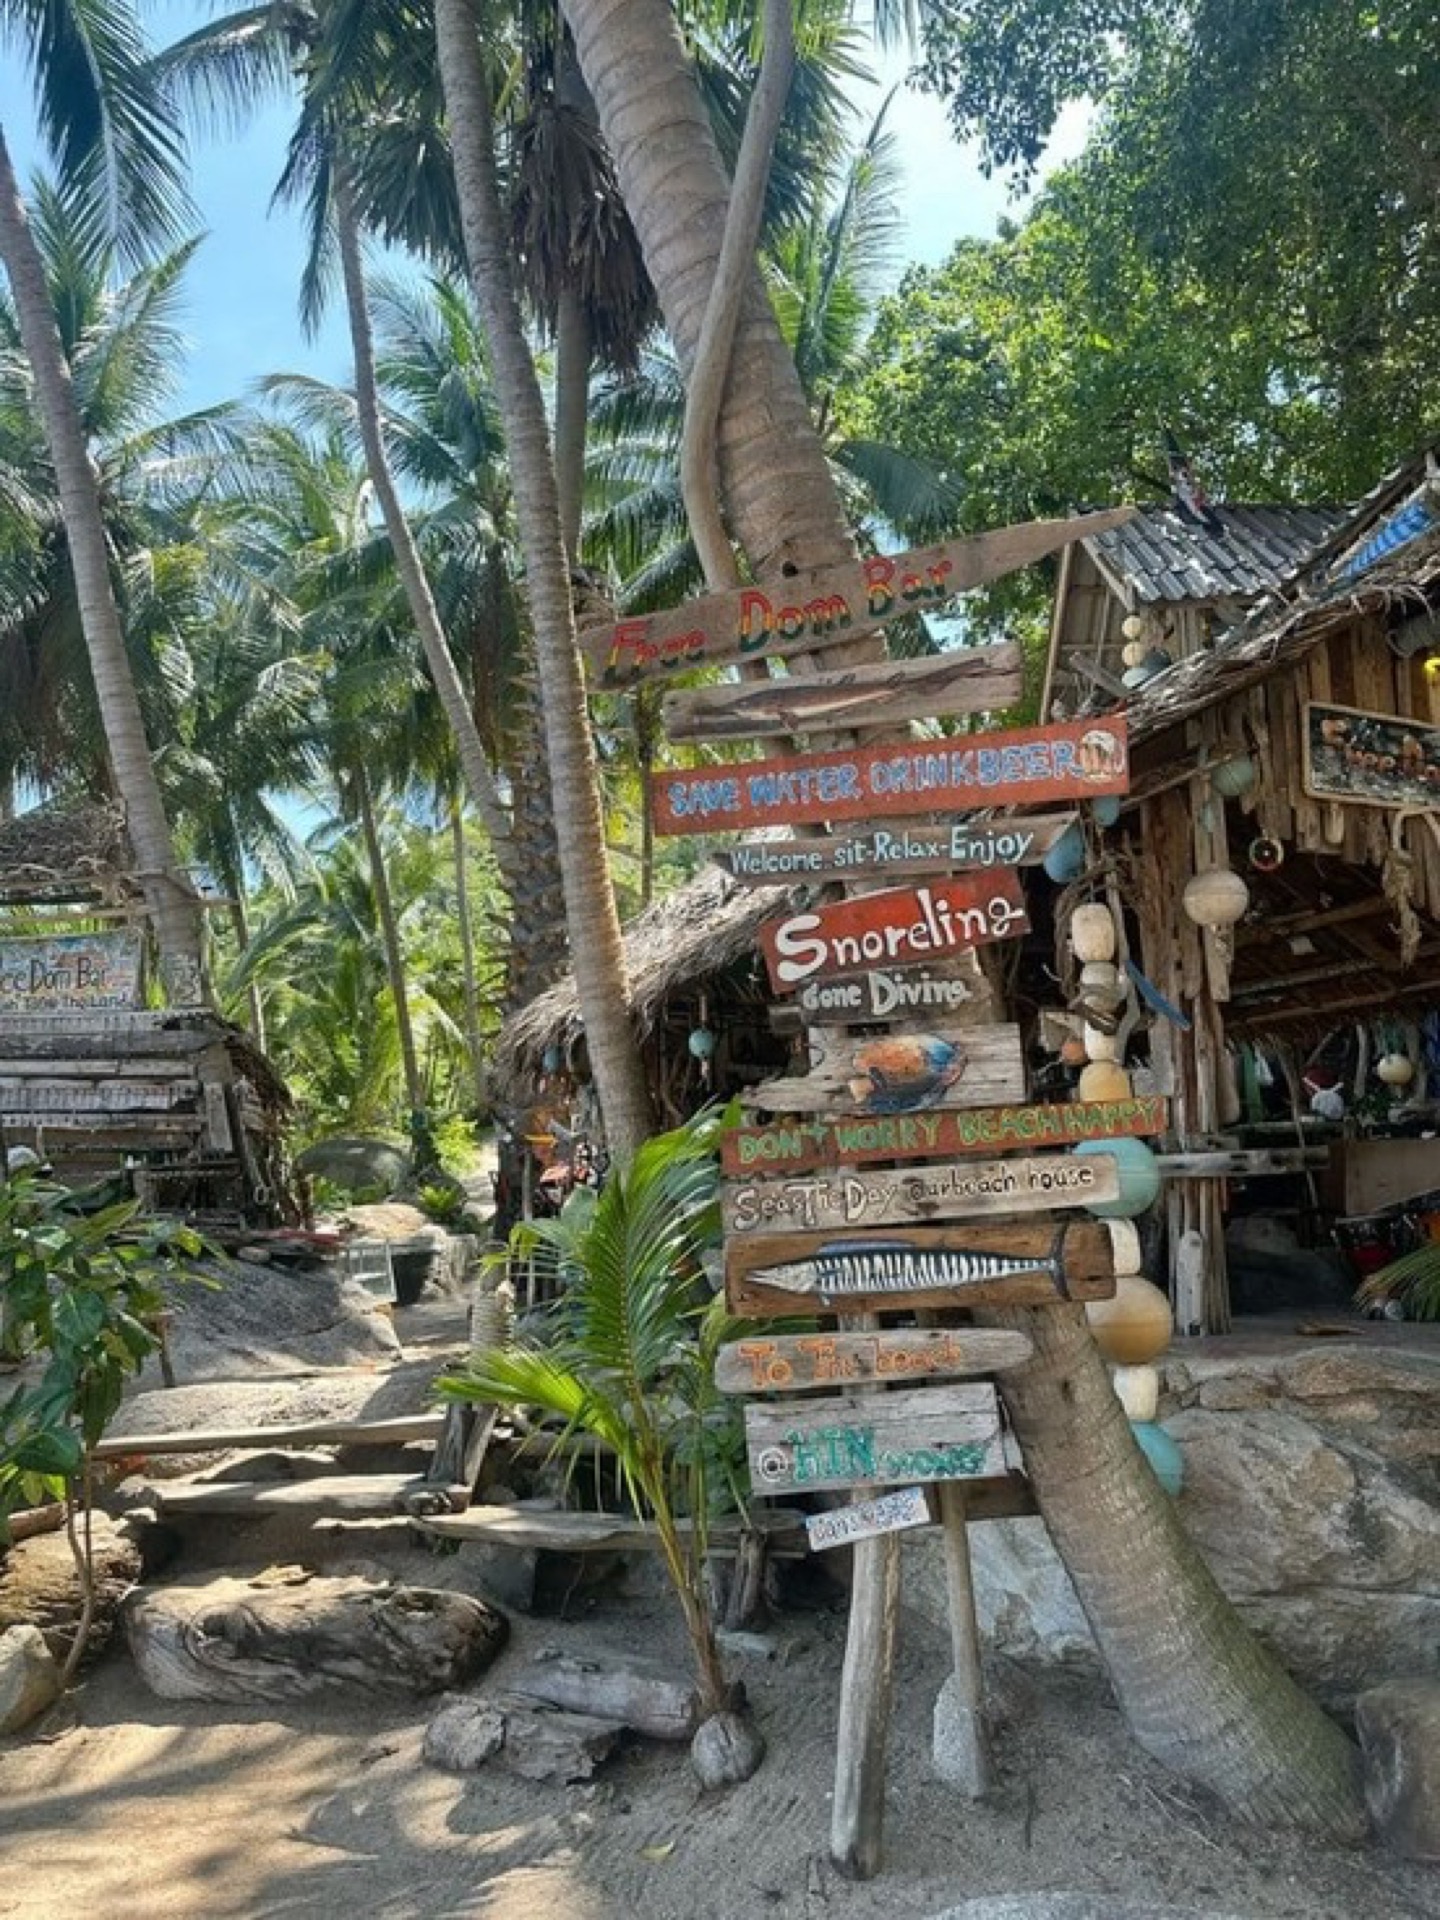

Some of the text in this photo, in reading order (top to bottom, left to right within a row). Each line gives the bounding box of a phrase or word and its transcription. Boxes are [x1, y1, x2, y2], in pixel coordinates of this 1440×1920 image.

[740, 588, 851, 653] Dom
[863, 556, 953, 616] Bar
[667, 777, 742, 817] SAVE
[747, 763, 863, 806] WATER
[869, 971, 974, 1016] Diving
[833, 1114, 944, 1153] WORRY
[739, 1341, 793, 1388] To
